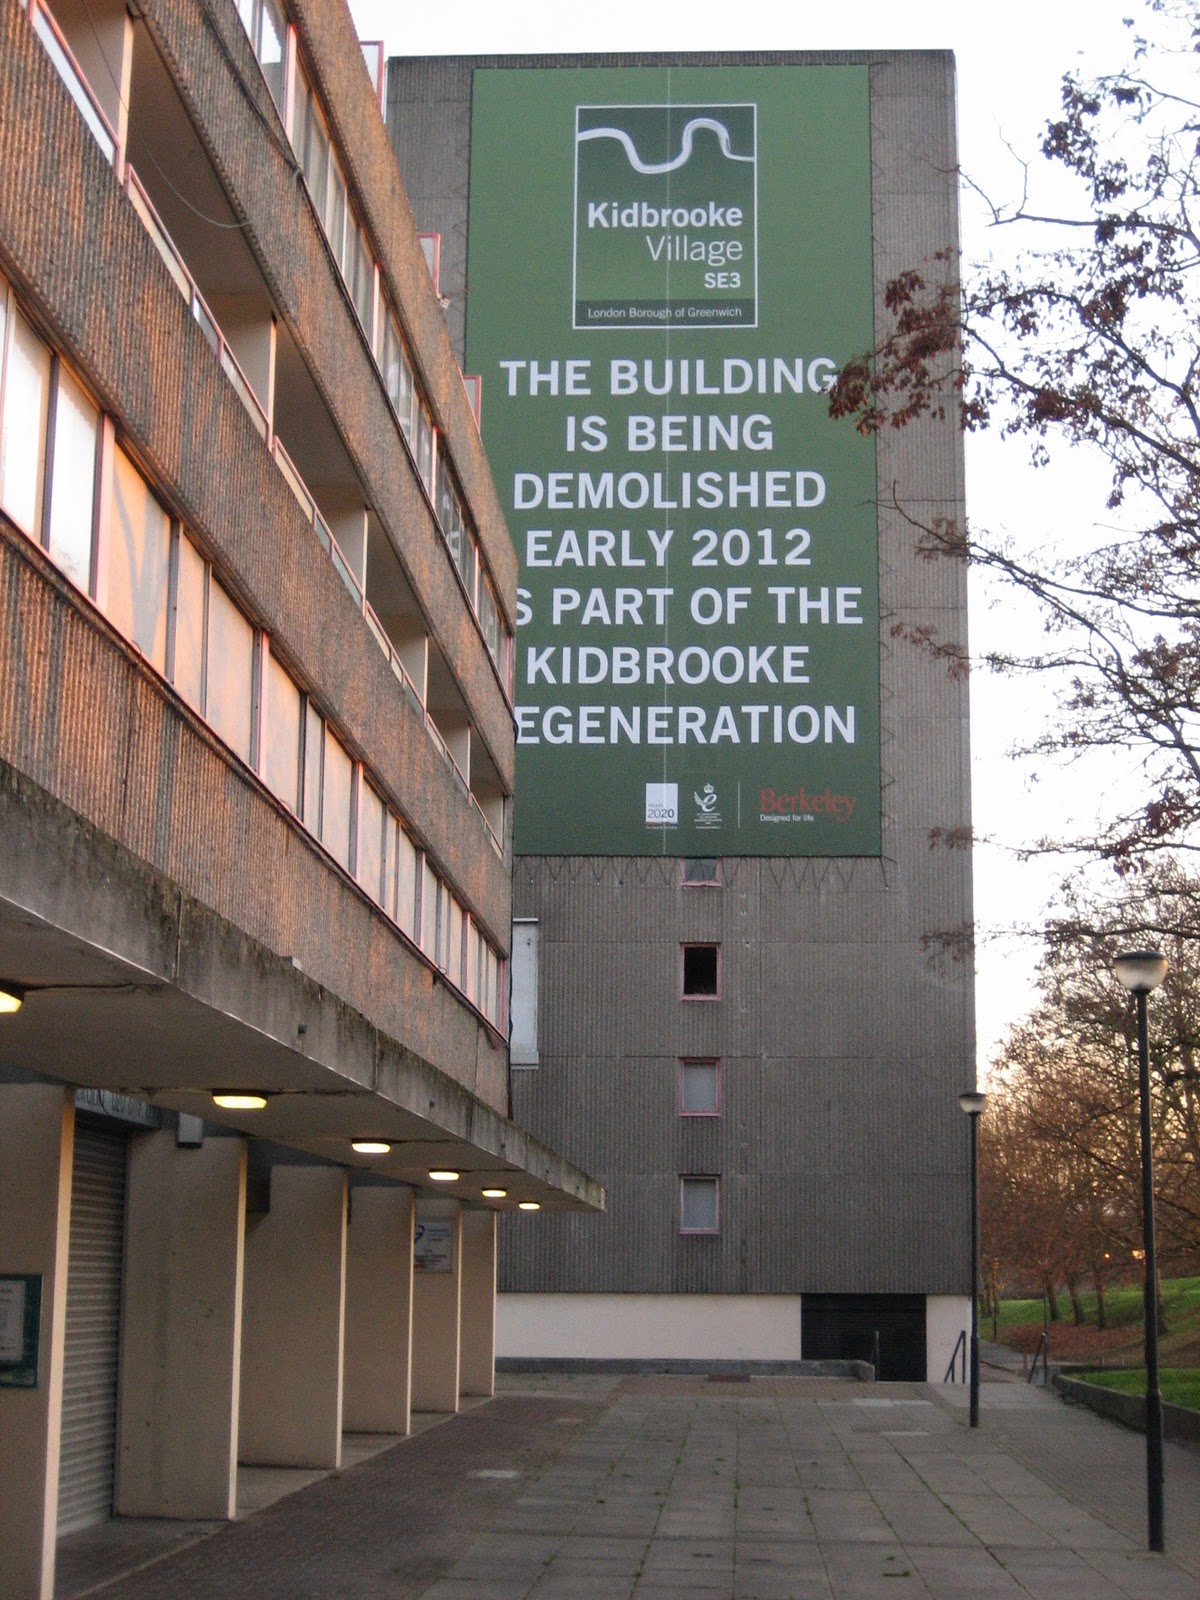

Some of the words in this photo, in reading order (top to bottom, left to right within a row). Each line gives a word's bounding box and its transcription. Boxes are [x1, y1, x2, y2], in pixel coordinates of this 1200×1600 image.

[589, 202, 742, 227] Kidbrooke
[646, 235, 743, 267] Village
[704, 272, 741, 289] SE3
[587, 308, 626, 319] London
[629, 307, 673, 320] Borough
[674, 307, 685, 318] of
[687, 307, 742, 318] Greenwich
[500, 360, 591, 395] THE
[611, 358, 837, 395] BUILDING
[567, 416, 607, 451] IS
[628, 415, 772, 451] BEING
[514, 471, 825, 509] DEMOLISHED
[527, 530, 673, 566] EARLY
[692, 529, 810, 566] 2012
[517, 588, 532, 625] S
[553, 588, 673, 624] PART
[691, 588, 751, 624] OF
[768, 587, 862, 624] THE
[528, 646, 809, 684] KIDBROOKE
[515, 705, 854, 744] EGENERATION
[647, 808, 675, 819] 2020
[760, 787, 855, 823] Berkeley
[760, 814, 790, 822] Designed
